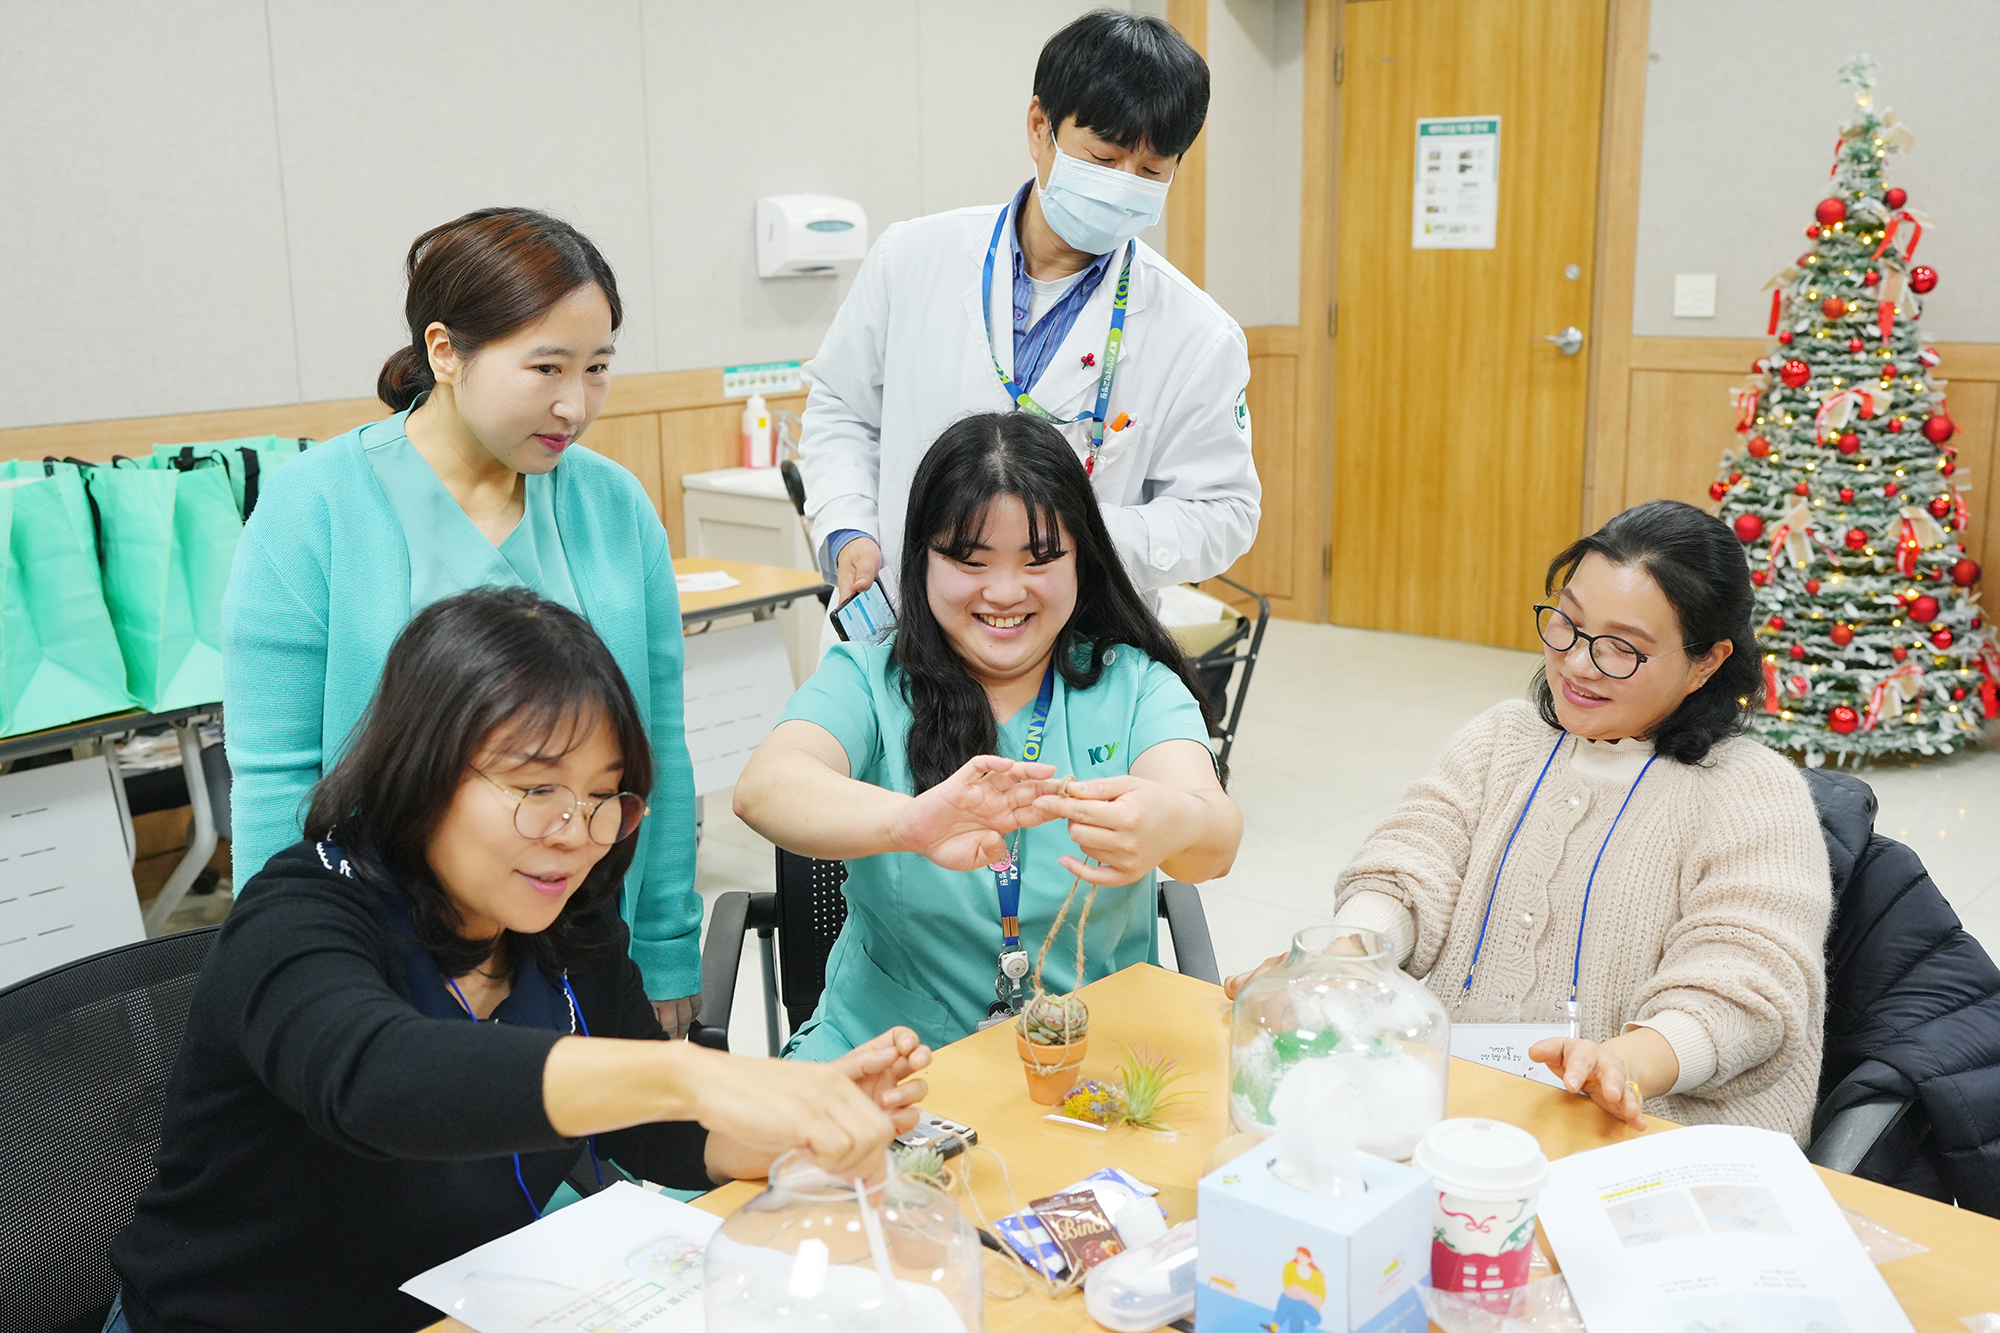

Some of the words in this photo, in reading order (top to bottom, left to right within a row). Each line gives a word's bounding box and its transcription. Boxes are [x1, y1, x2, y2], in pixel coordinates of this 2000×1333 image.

[1100, 356, 1115, 399] 건양대학교병원
[1023, 700, 1050, 760] ONYA
[1088, 742, 1119, 765] KY
[999, 871, 1008, 886] 병원
[1056, 1212, 1112, 1241] Binch
